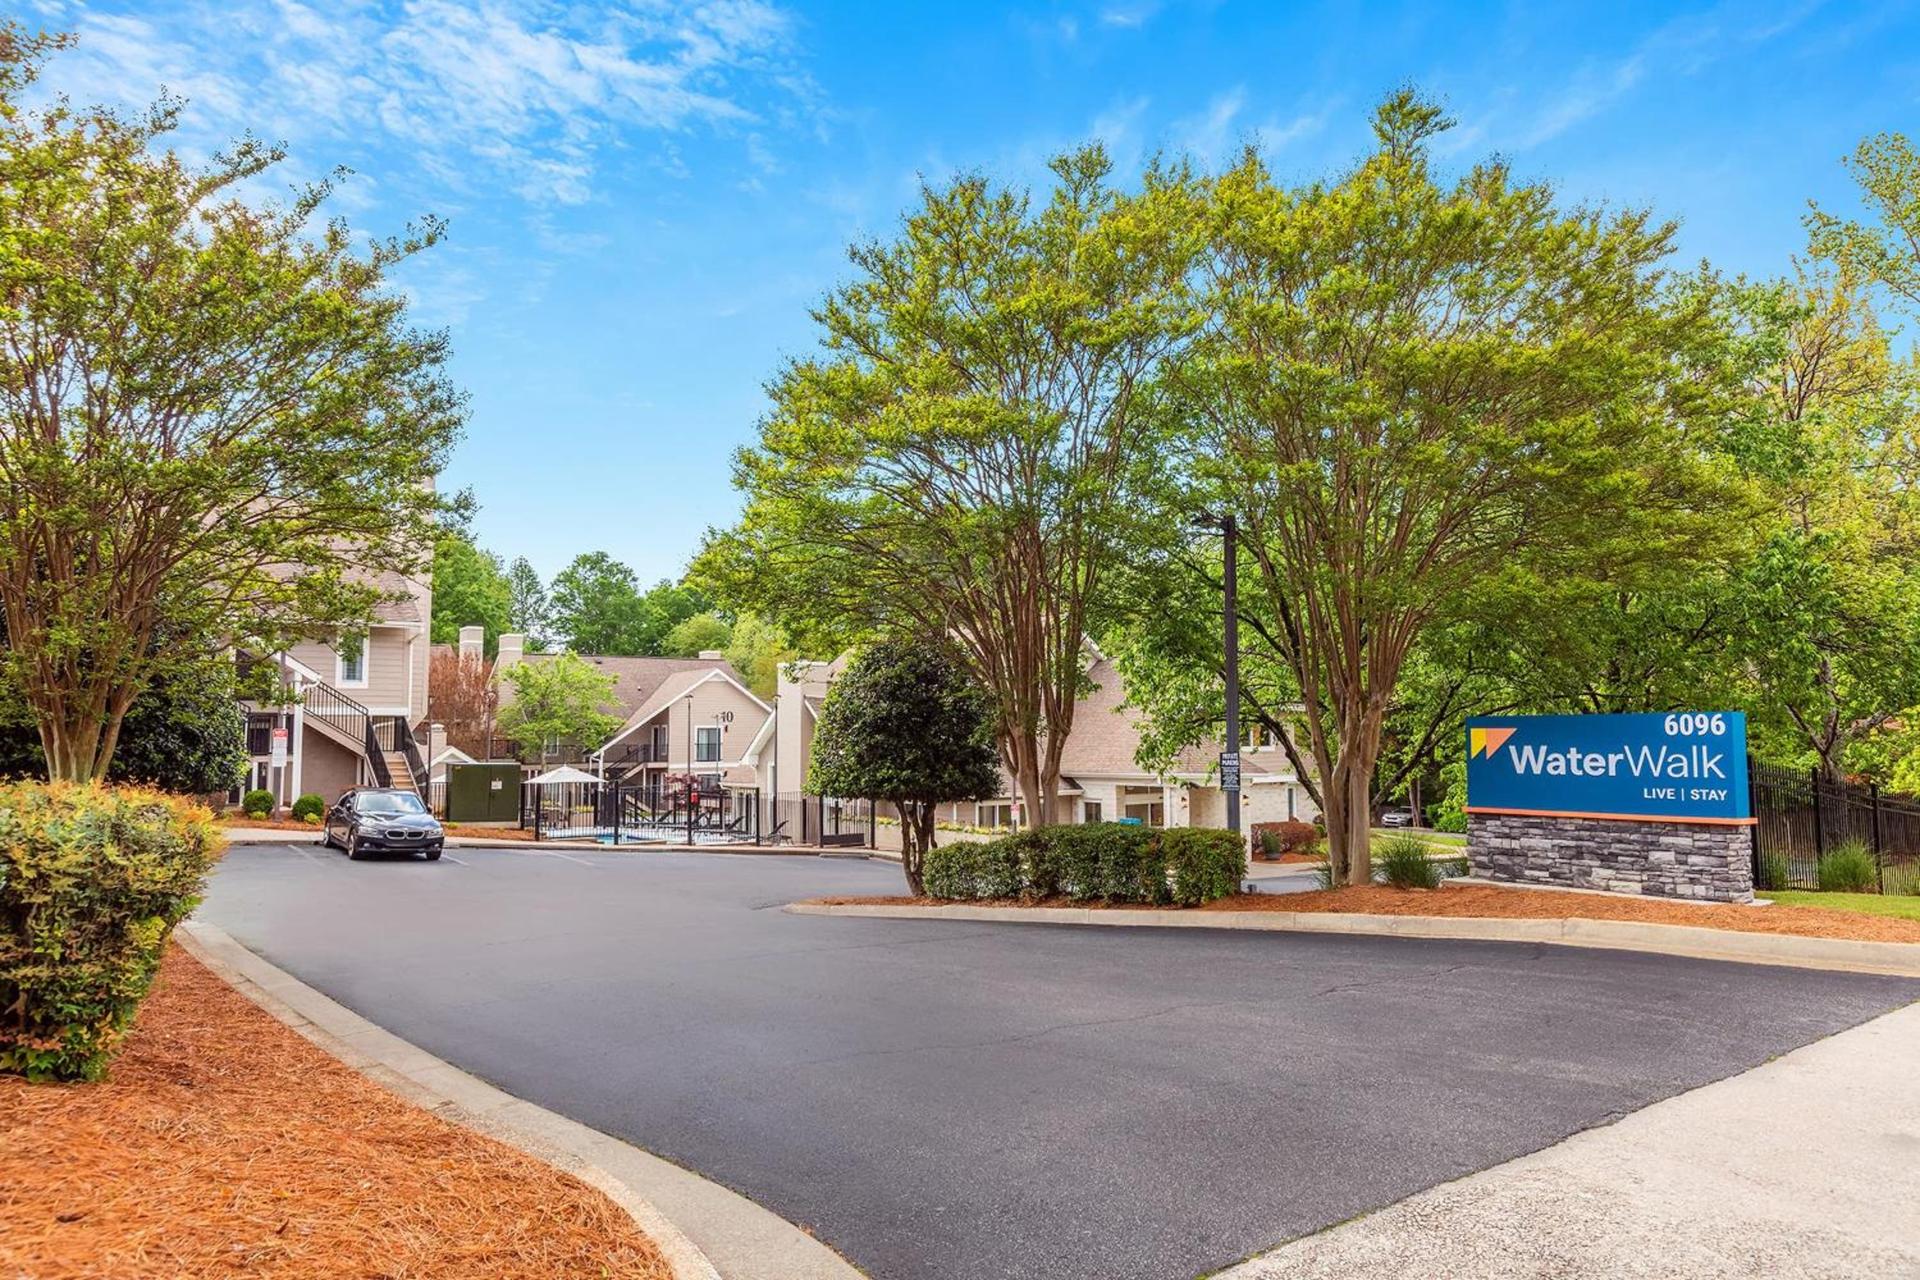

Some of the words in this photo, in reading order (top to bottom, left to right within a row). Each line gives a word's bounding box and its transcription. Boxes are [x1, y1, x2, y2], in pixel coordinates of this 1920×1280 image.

[1664, 713, 1726, 736] 6096
[1508, 745, 1727, 779] WaterWalk
[1643, 787, 1676, 800] LIVE
[1690, 788, 1728, 801] STAY
